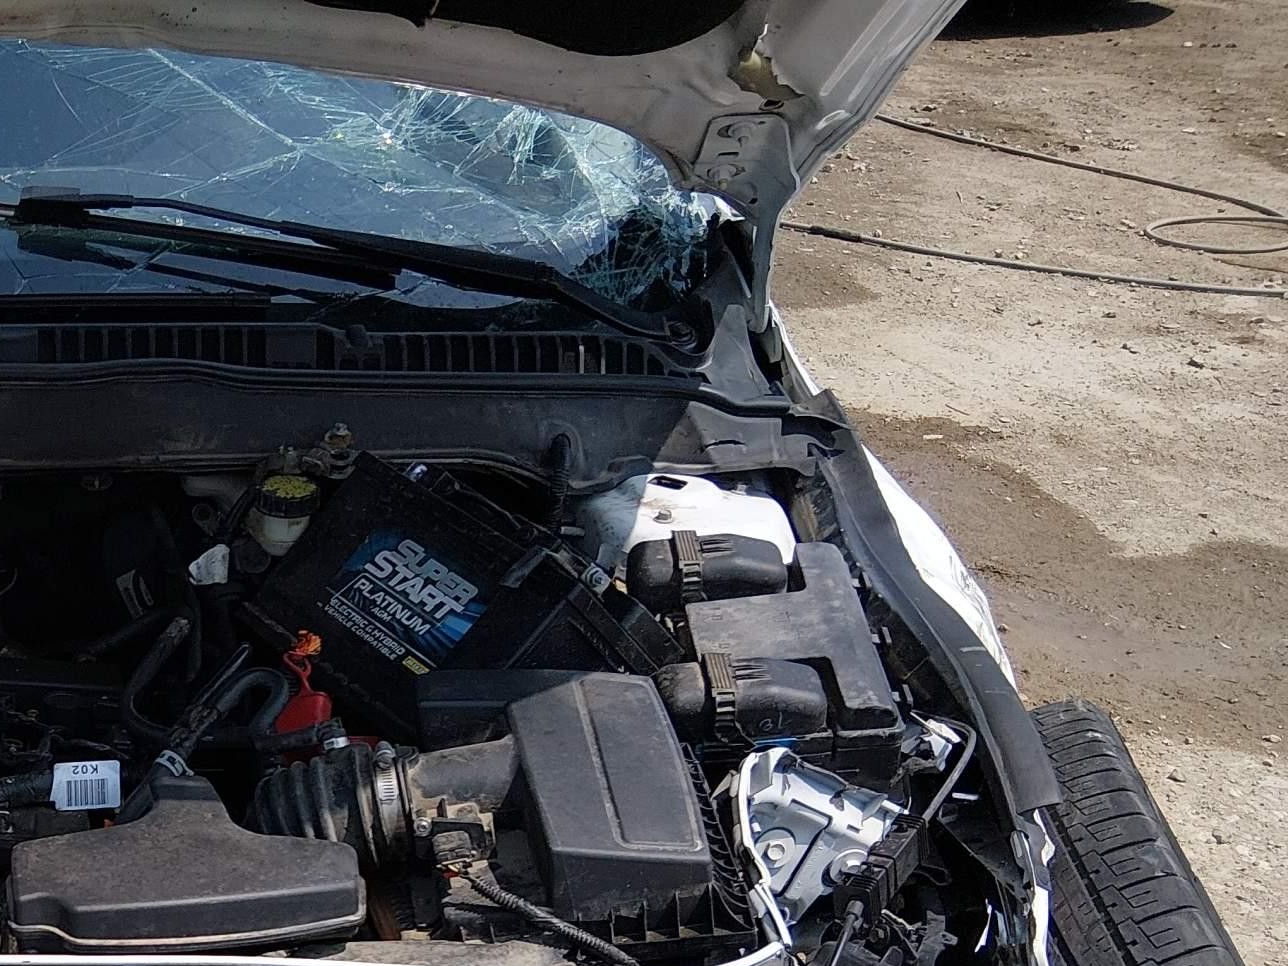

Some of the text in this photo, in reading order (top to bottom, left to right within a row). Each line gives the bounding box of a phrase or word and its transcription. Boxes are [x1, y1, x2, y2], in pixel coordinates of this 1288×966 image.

[364, 550, 465, 619] START
[391, 538, 479, 605] SUPER
[324, 603, 398, 661] VEHICLE COMPATIBLE
[330, 598, 369, 628] ELECTRIC
[372, 628, 406, 656] HYBRID
[353, 578, 432, 636] PLATINUM
[371, 606, 393, 622] AGM
[72, 764, 99, 775] K02
